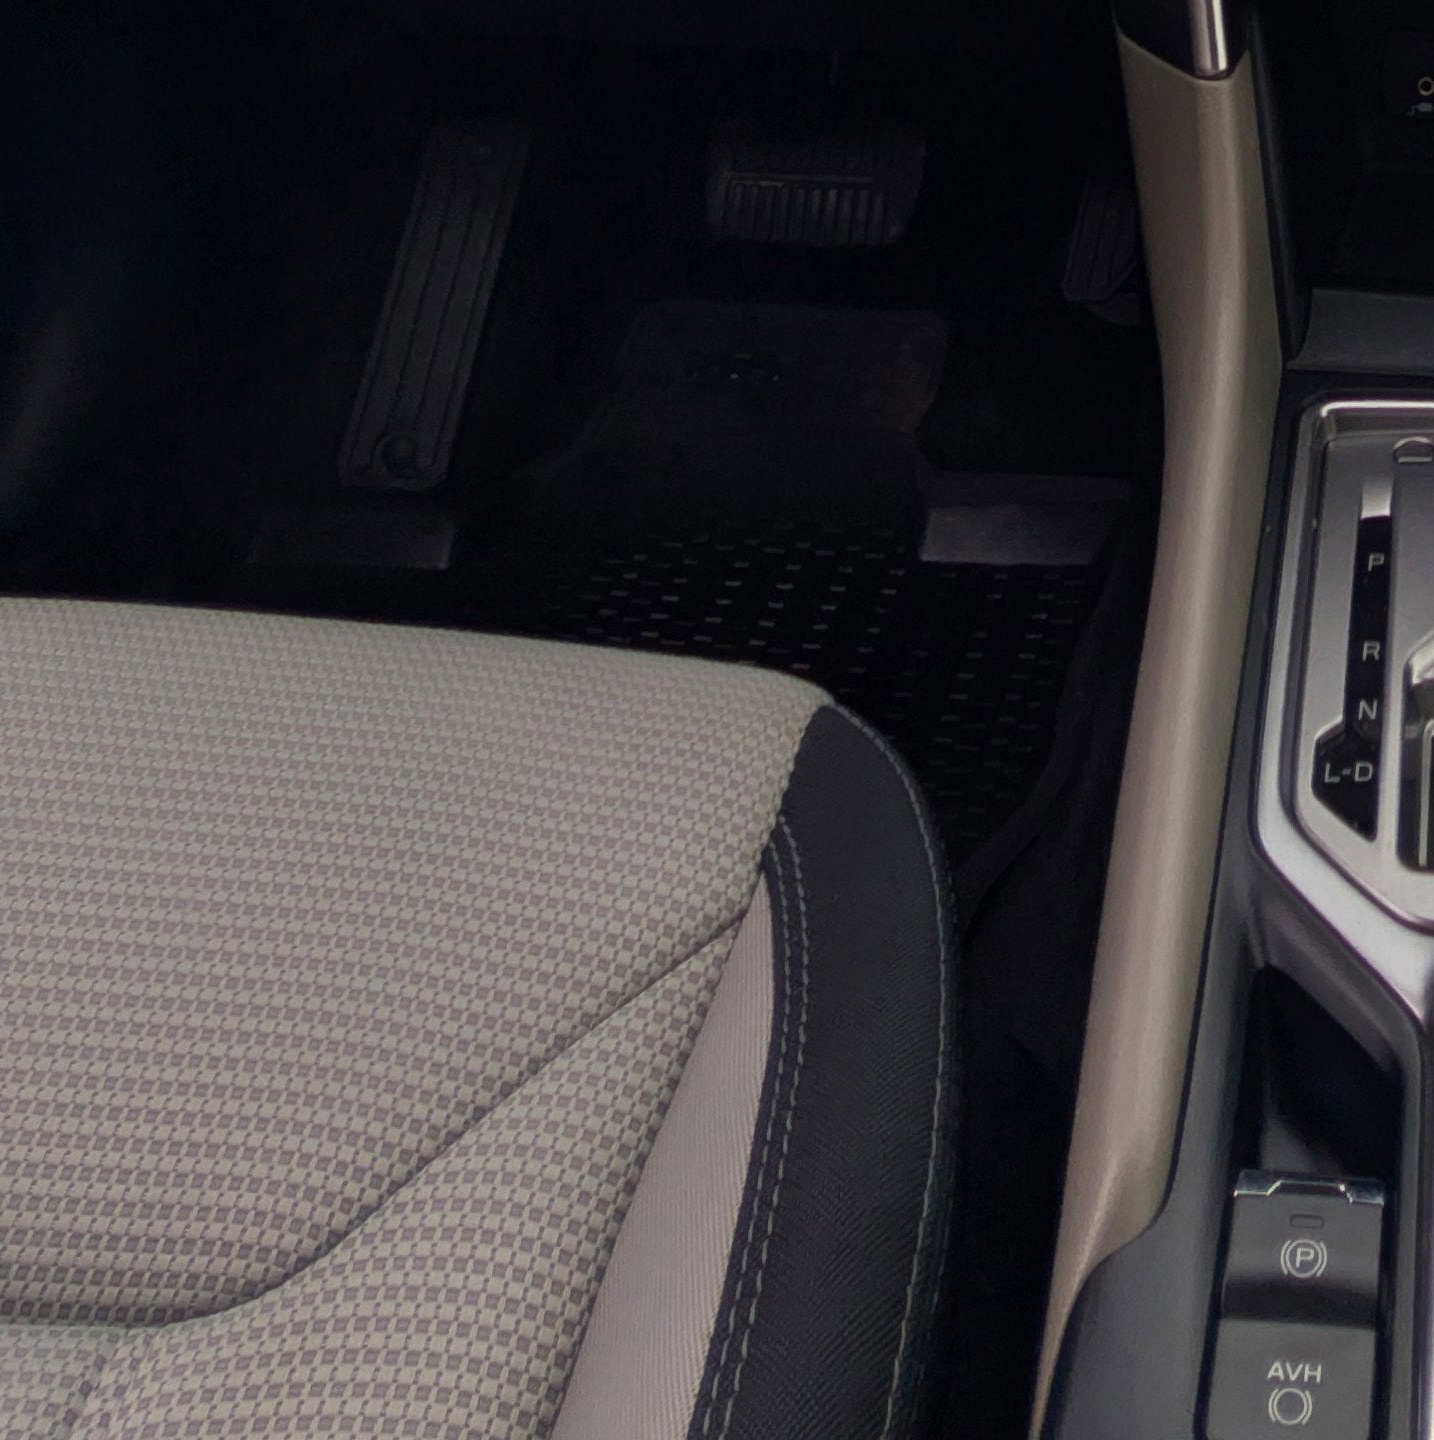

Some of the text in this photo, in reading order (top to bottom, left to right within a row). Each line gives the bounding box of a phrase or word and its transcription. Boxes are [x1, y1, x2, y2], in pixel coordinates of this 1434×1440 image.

[1368, 553, 1385, 572] P
[1362, 640, 1381, 661] R
[1358, 699, 1378, 720] N
[1295, 1247, 1315, 1268] P
[1267, 1361, 1323, 1384] AVH
